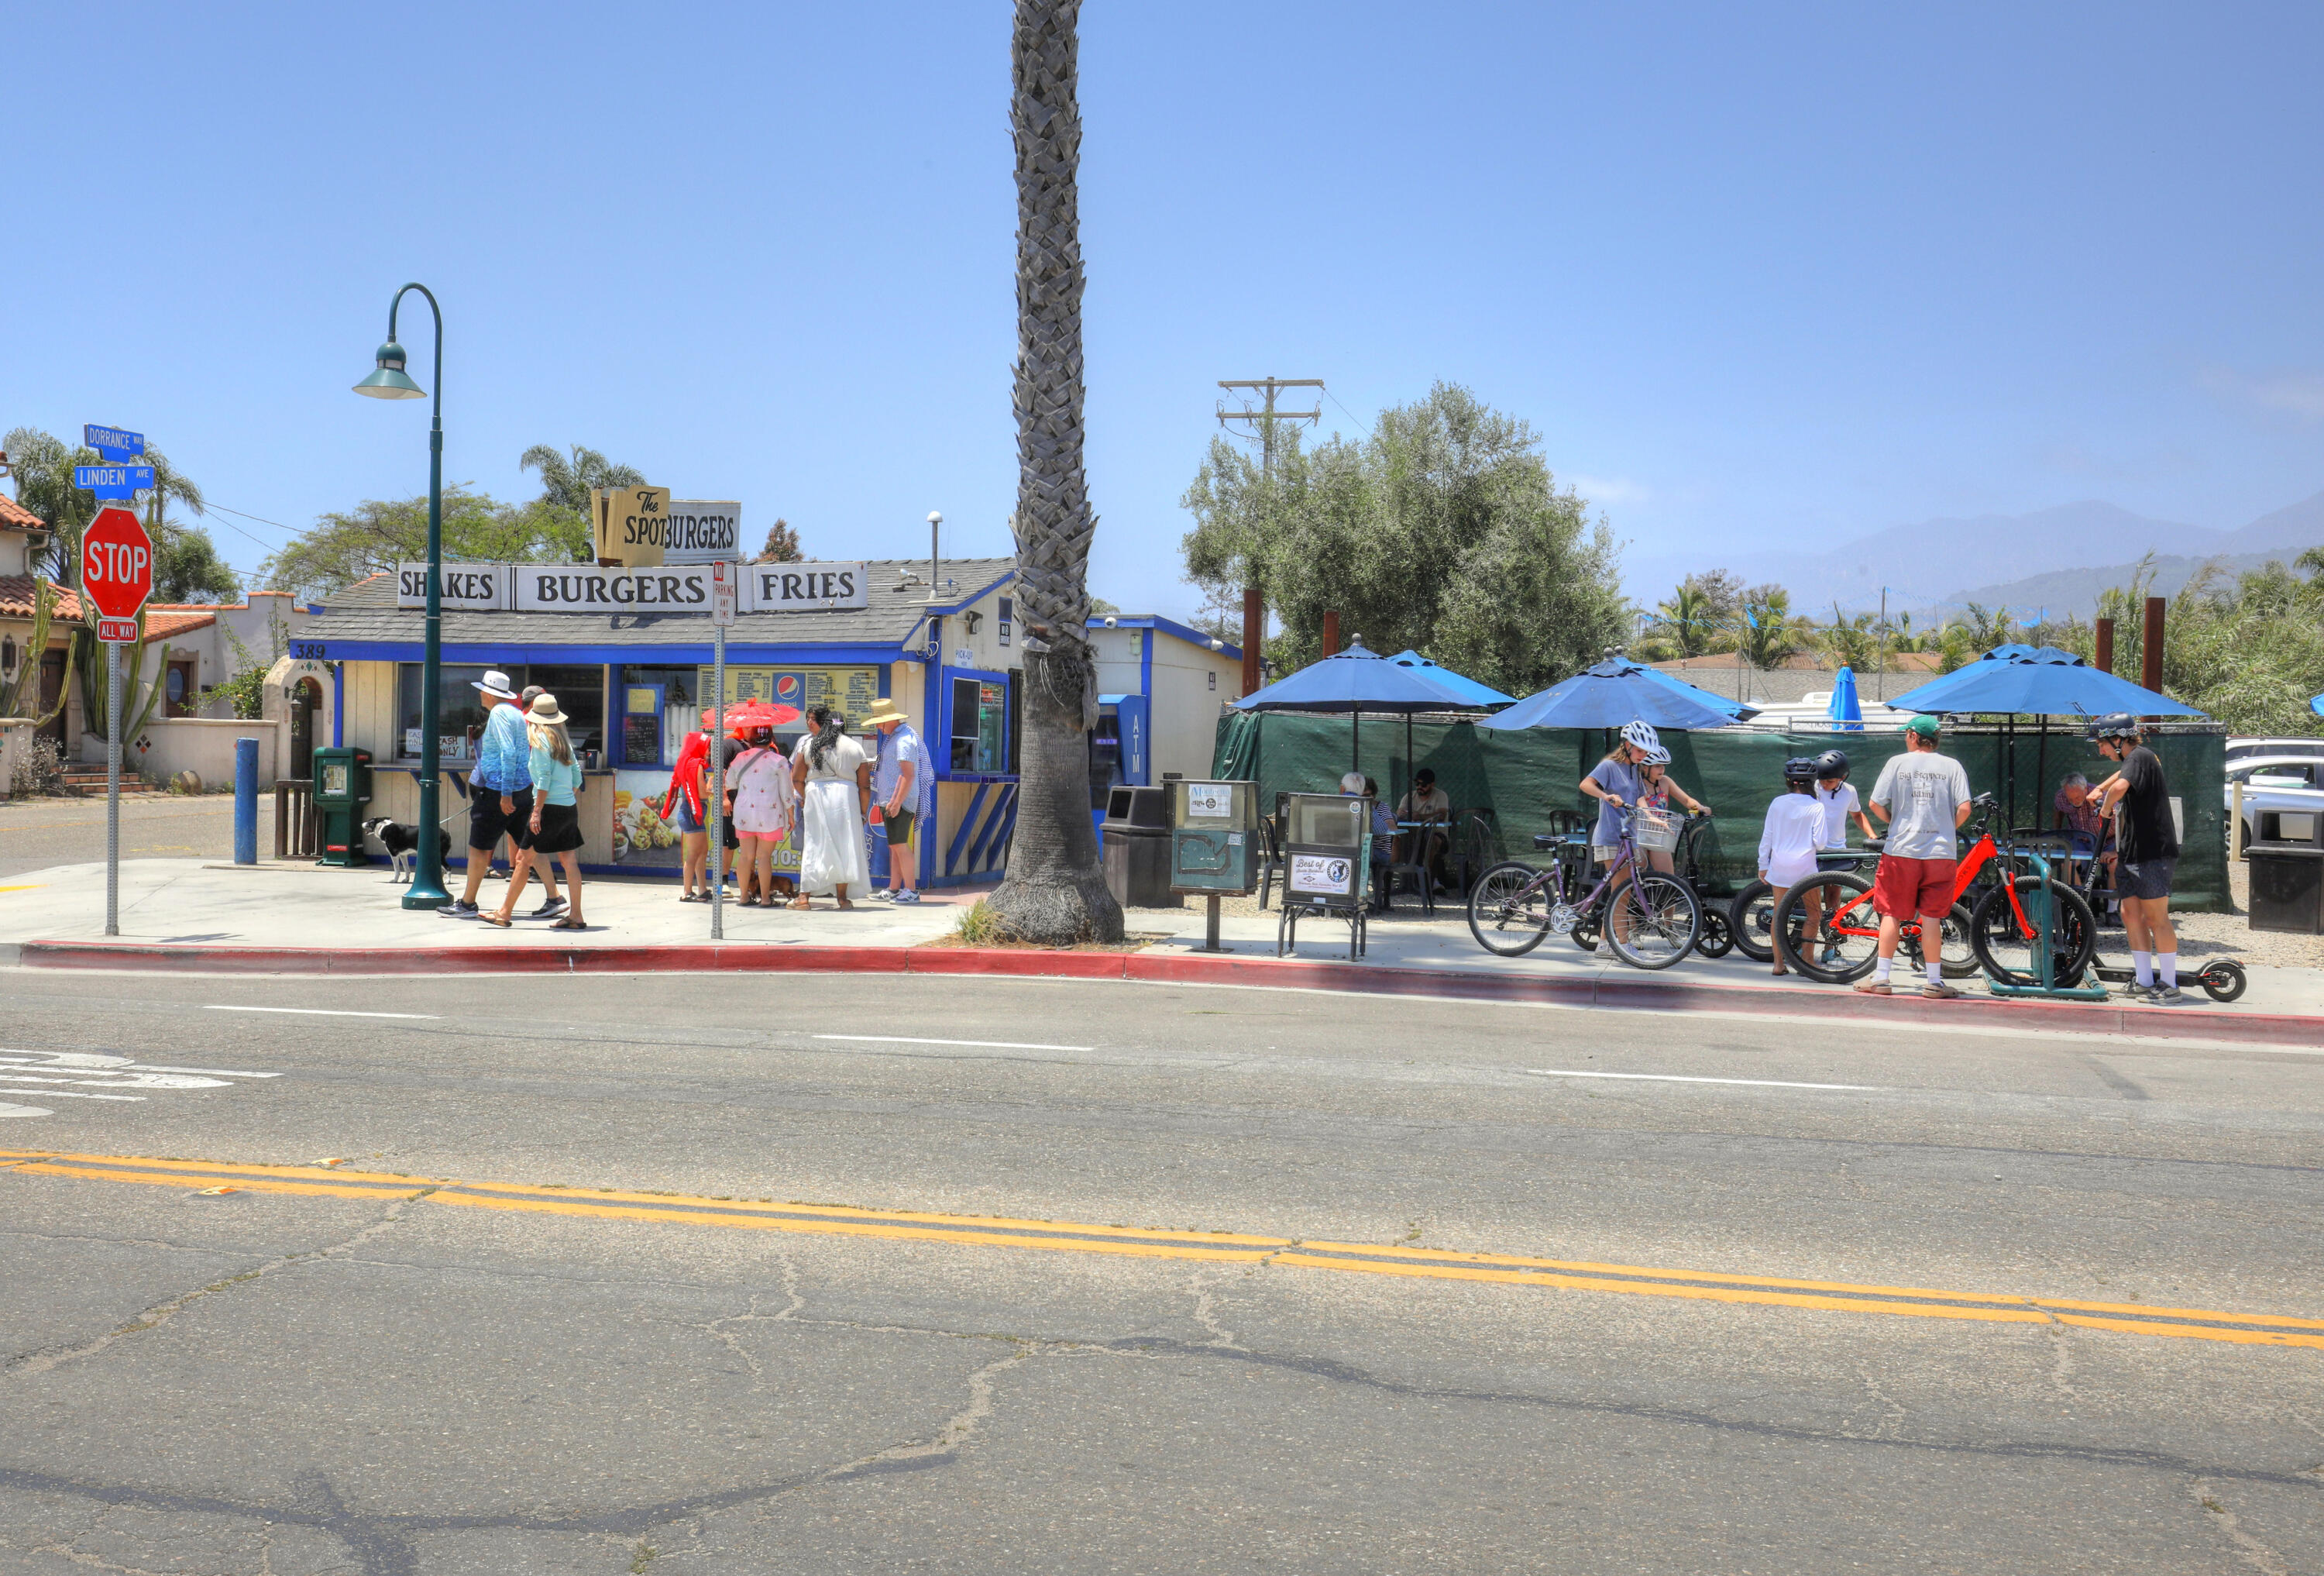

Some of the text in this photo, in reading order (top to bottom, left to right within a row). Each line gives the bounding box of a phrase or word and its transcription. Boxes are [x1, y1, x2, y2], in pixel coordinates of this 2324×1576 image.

[89, 427, 143, 450] DORRANCE WAY
[80, 469, 150, 486] LINDEN AVE
[636, 490, 659, 514] The
[624, 514, 734, 549] SPOT BURGERS
[88, 540, 148, 584] STOP
[715, 564, 723, 578] NO
[401, 570, 493, 600] SHKES
[537, 575, 706, 603] BURGERS
[715, 583, 734, 597] PARKING
[761, 571, 855, 600] FRIES
[720, 598, 728, 608] ANY
[719, 610, 729, 620] TIME
[101, 624, 134, 638] ALL WAY
[296, 644, 325, 659] 389
[955, 649, 973, 660] PICK-UP
[408, 738, 423, 747] ONL
[1296, 859, 1325, 869] Best of
[2083, 872, 2095, 893] hiboy
